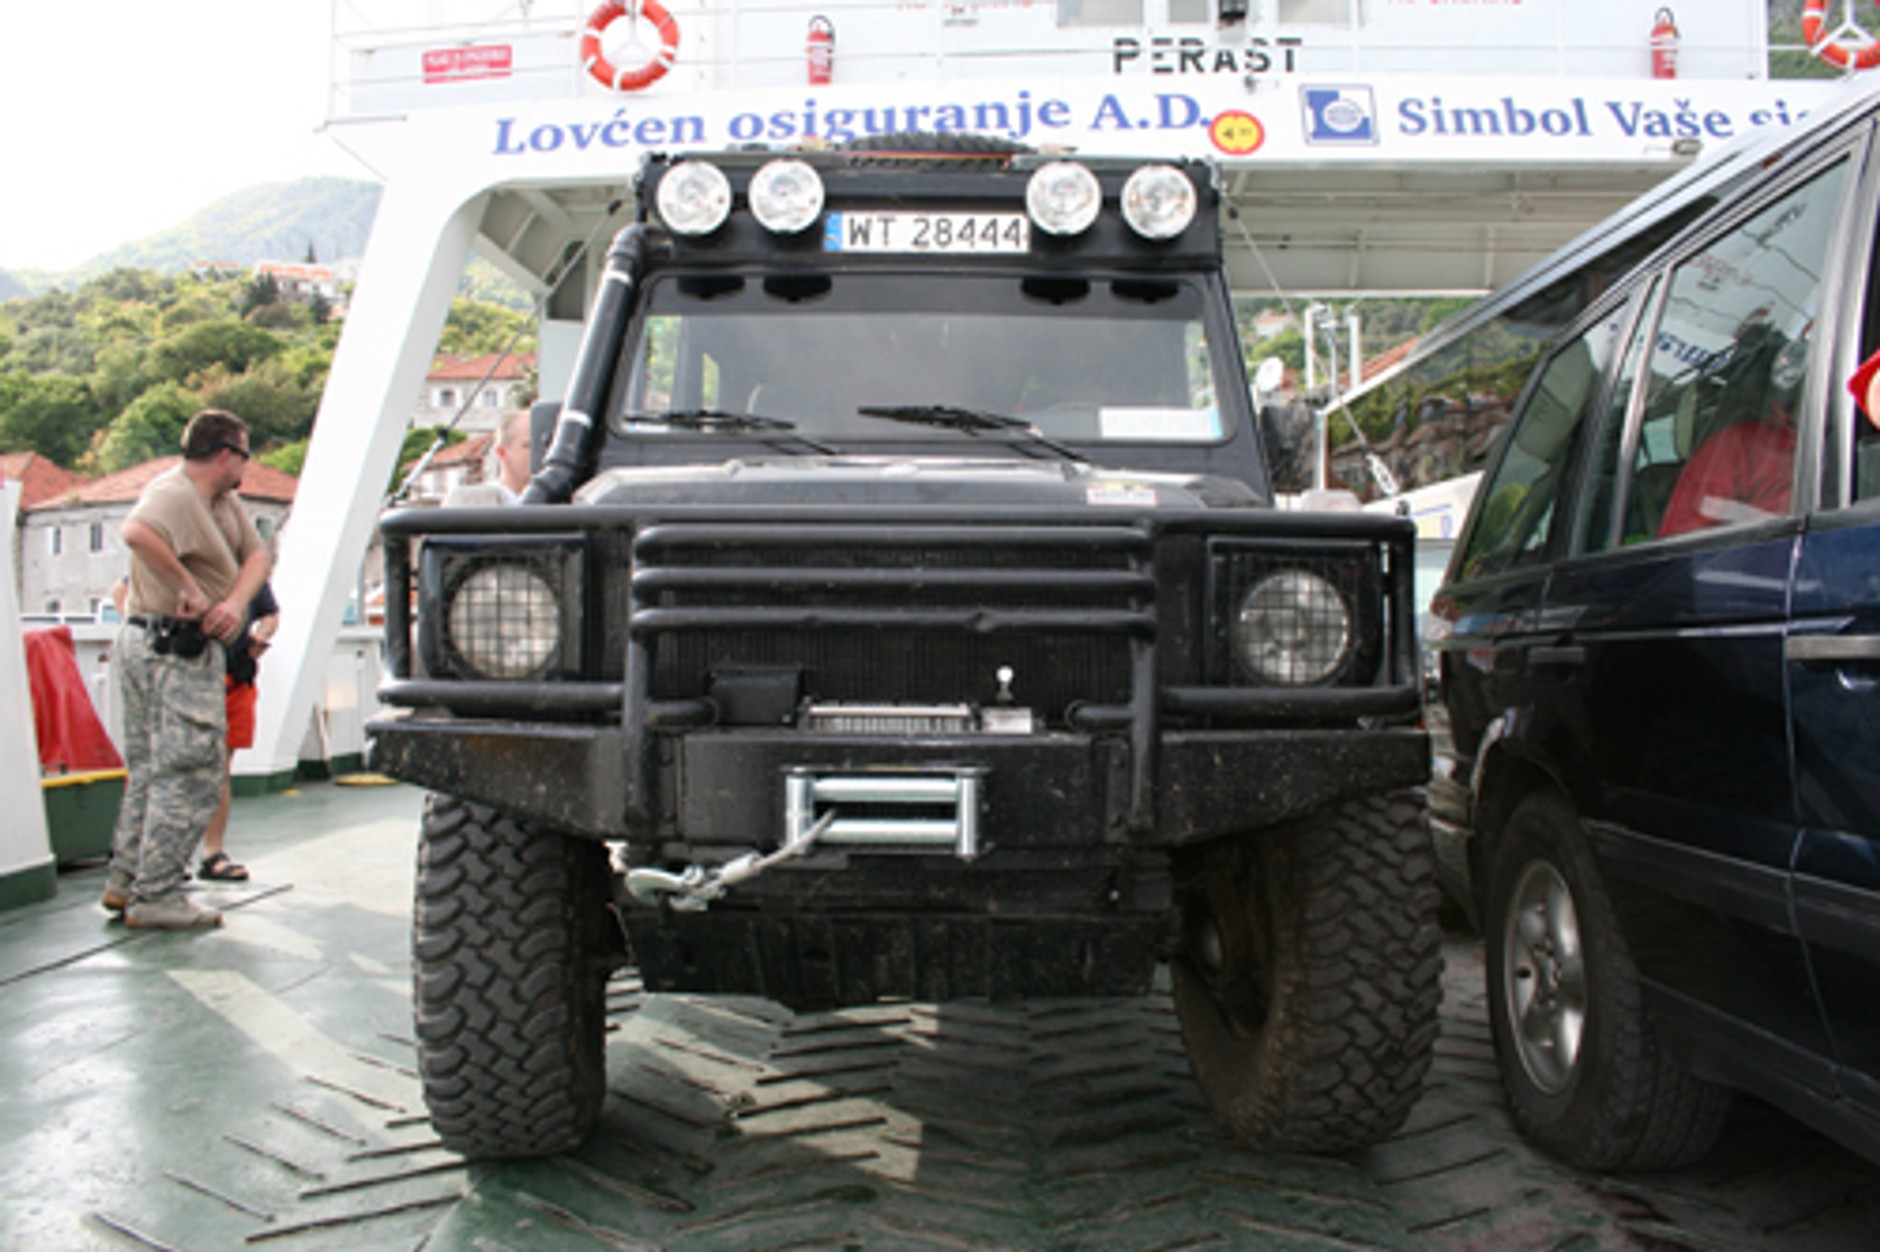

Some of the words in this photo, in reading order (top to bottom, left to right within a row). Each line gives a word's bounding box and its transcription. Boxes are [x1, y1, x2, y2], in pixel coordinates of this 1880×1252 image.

[1114, 38, 1302, 74] PERAST
[494, 108, 705, 155] Lovćen
[727, 90, 1070, 144] osiguranje
[1090, 93, 1211, 131] A.D.
[1398, 97, 1592, 136] Simbol
[1606, 99, 1734, 138] Vaše
[849, 217, 897, 246] WT
[912, 218, 1020, 248] 28444
